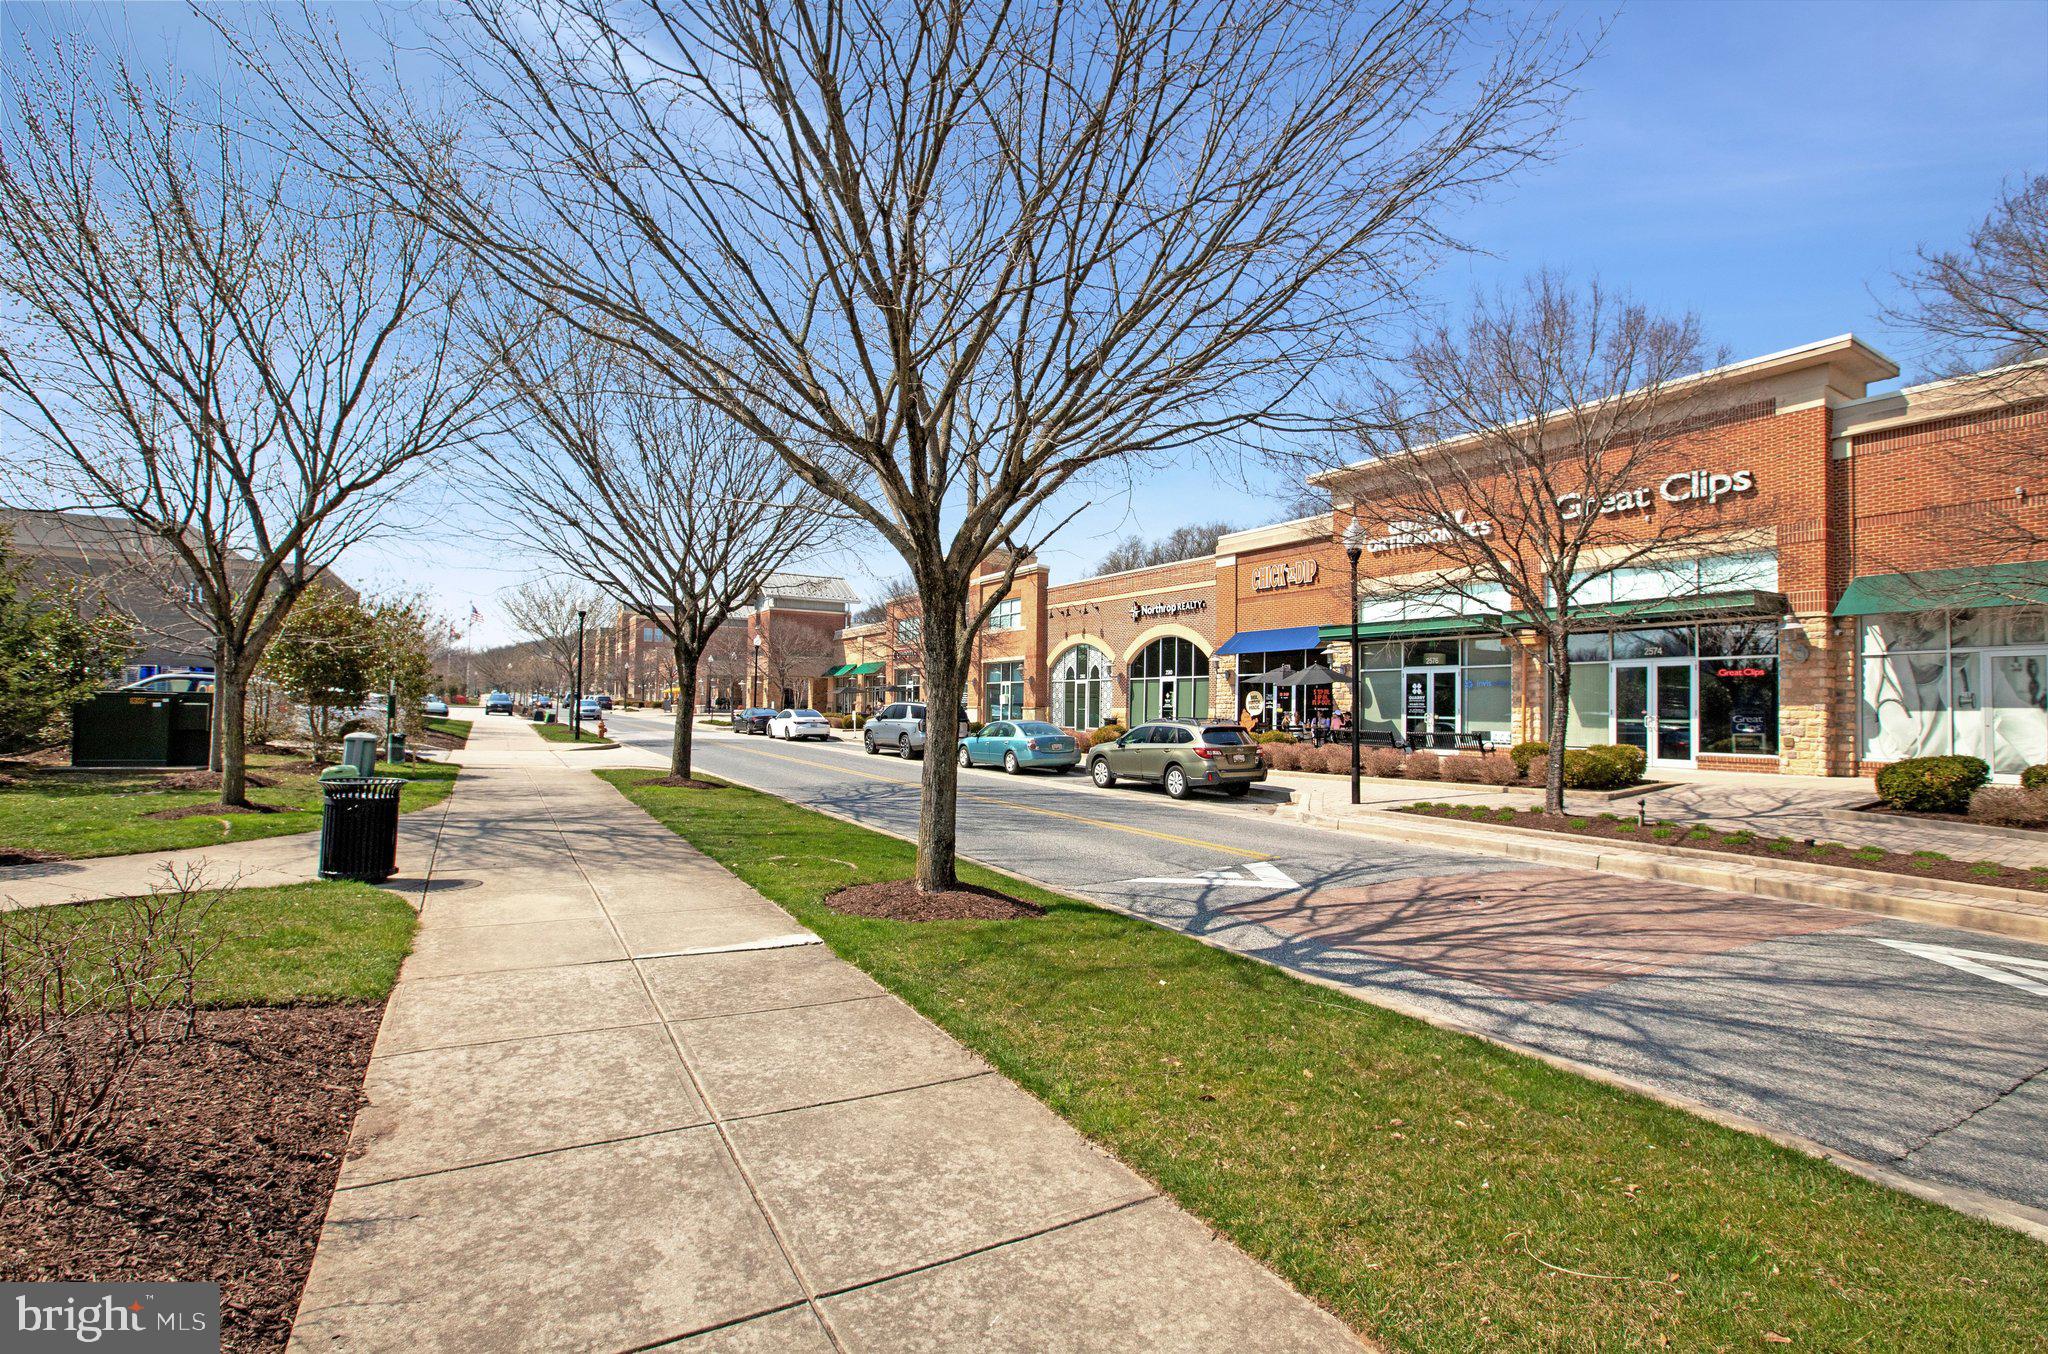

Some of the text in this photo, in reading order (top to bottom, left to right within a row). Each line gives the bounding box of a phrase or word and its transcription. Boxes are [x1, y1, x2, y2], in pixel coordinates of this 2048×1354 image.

[1557, 469, 1752, 520] Great Clips
[1252, 563, 1286, 590] CHICK
[1296, 559, 1317, 585] DIP
[1141, 600, 1203, 615] Northrop REALTY
[1644, 646, 1663, 656] 2574
[1425, 657, 1440, 665] 2576
[1718, 668, 1766, 677] Great Clips
[1732, 714, 1764, 723] Great
